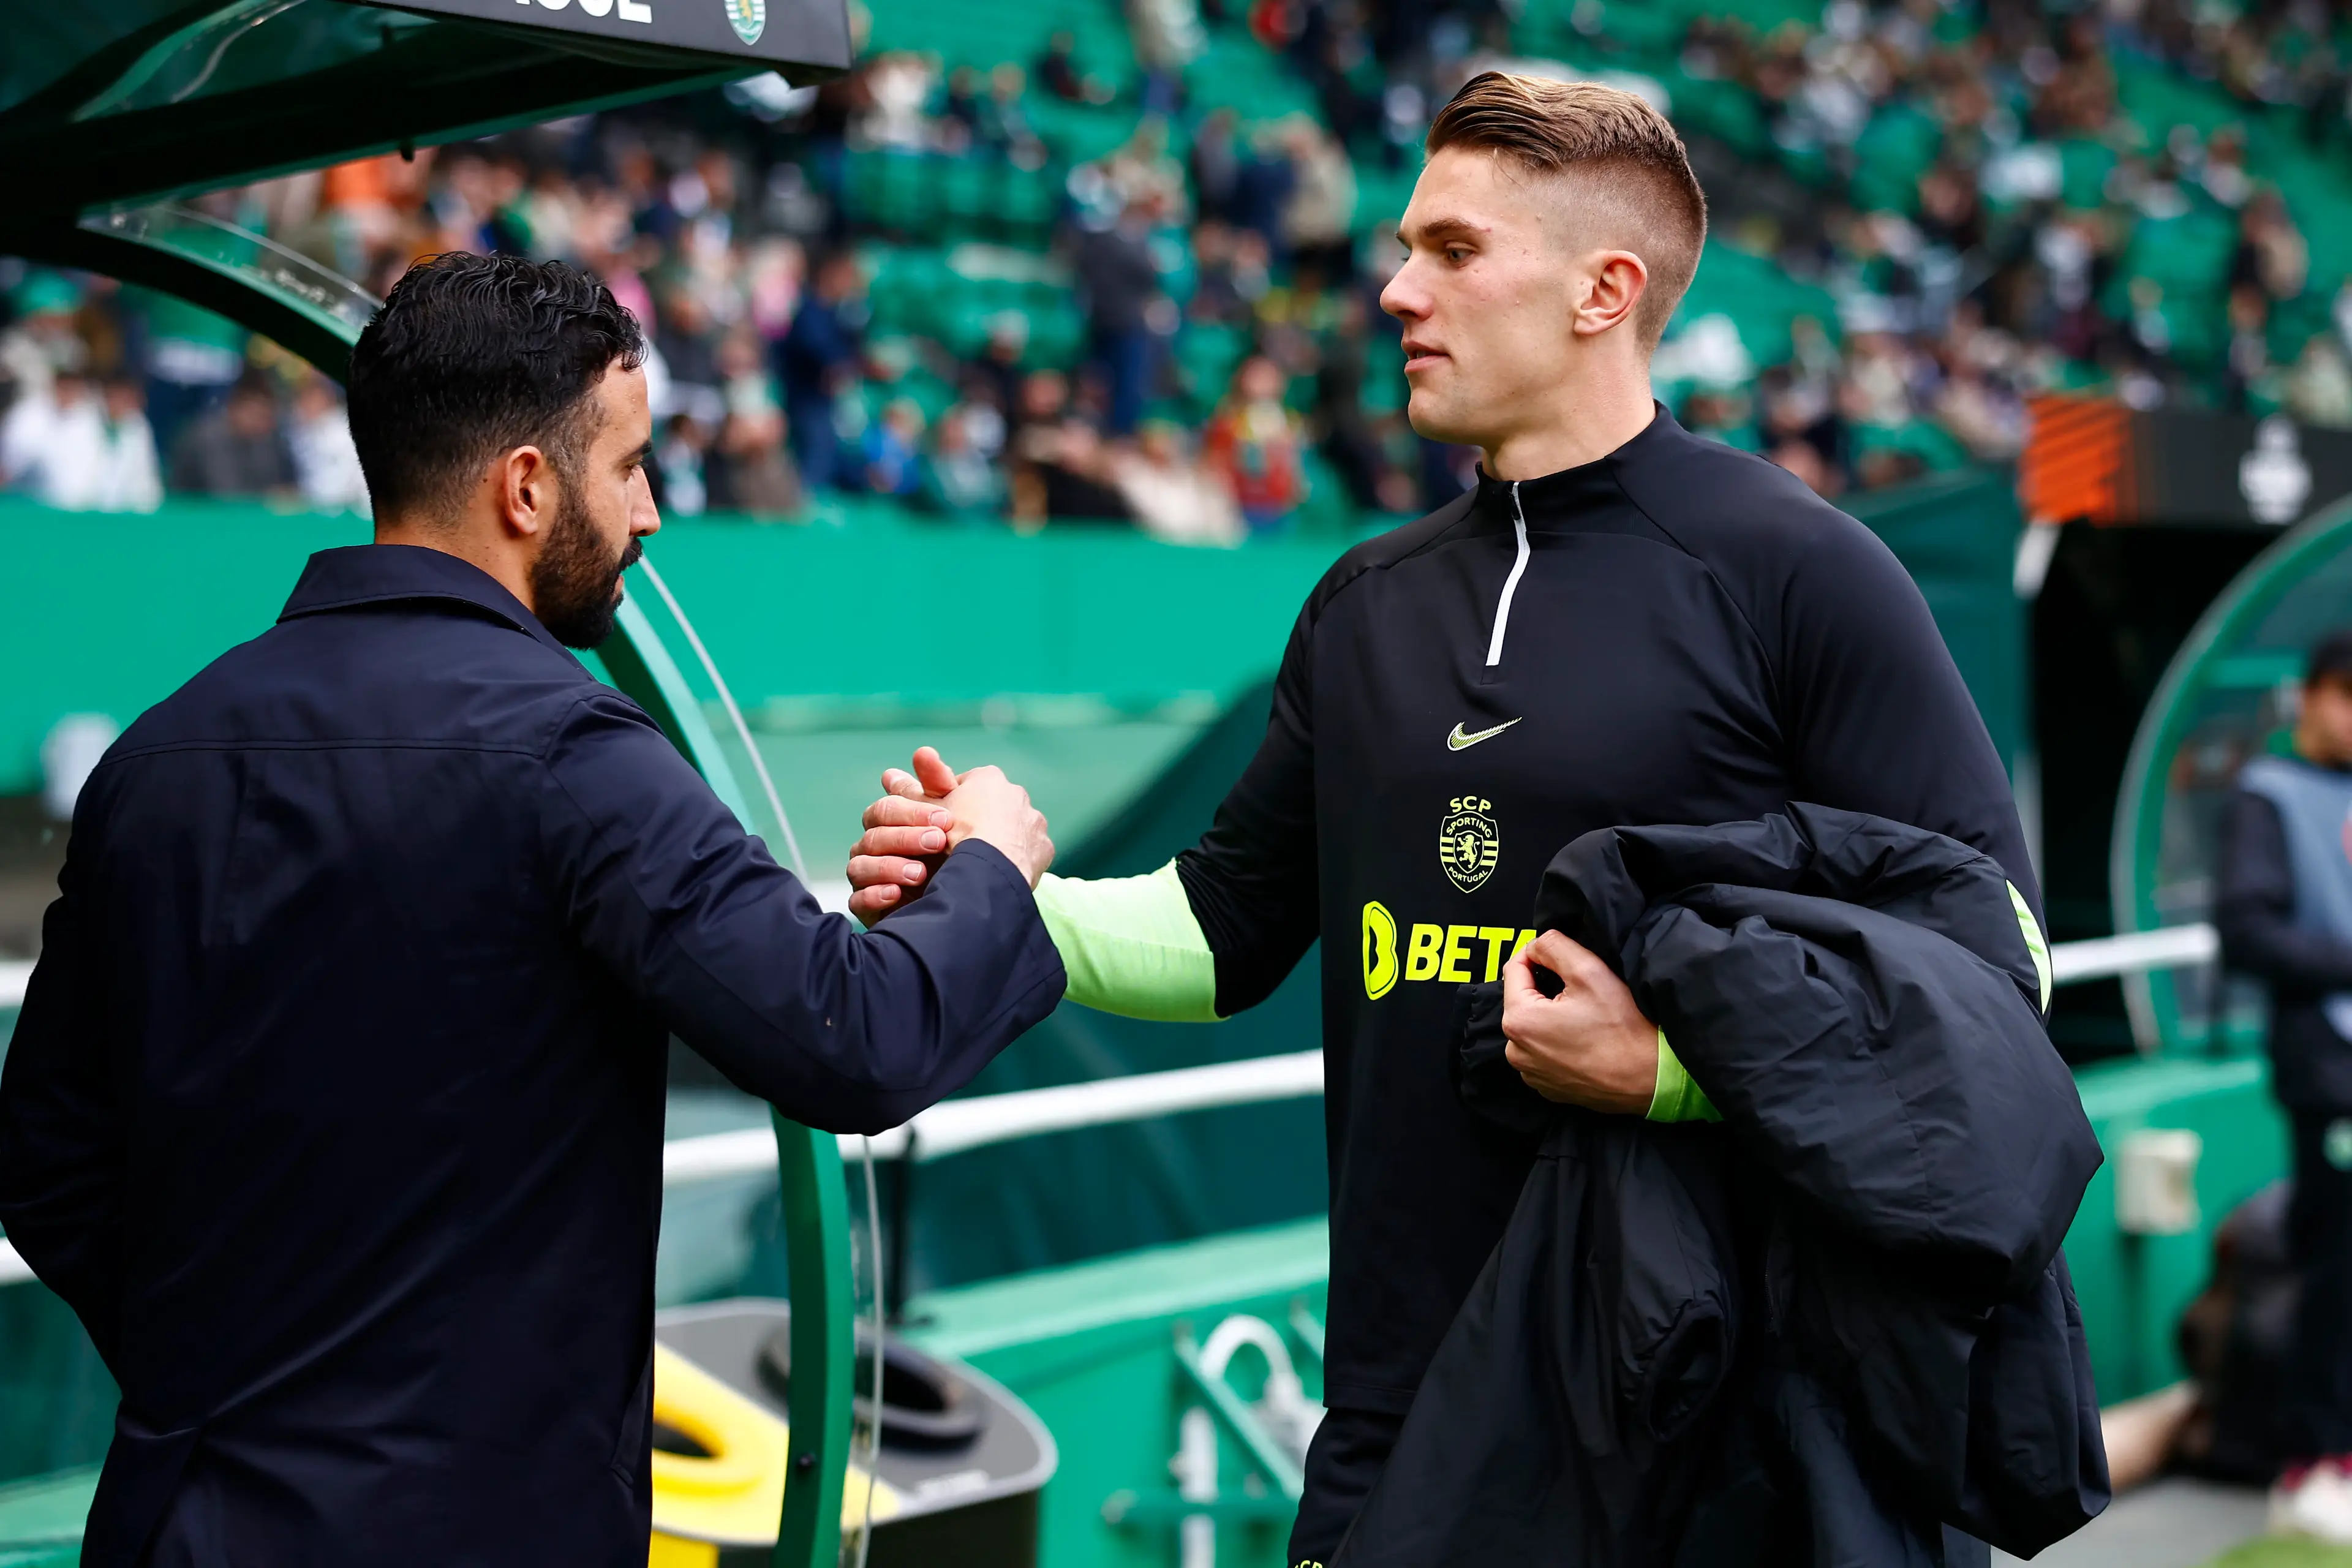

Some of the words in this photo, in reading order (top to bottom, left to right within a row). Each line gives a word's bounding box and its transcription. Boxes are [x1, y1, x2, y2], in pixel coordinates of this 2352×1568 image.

[1450, 796, 1491, 813] SCP
[1446, 817, 1492, 838] SPORTING
[1448, 866, 1488, 883] PORTUGAL
